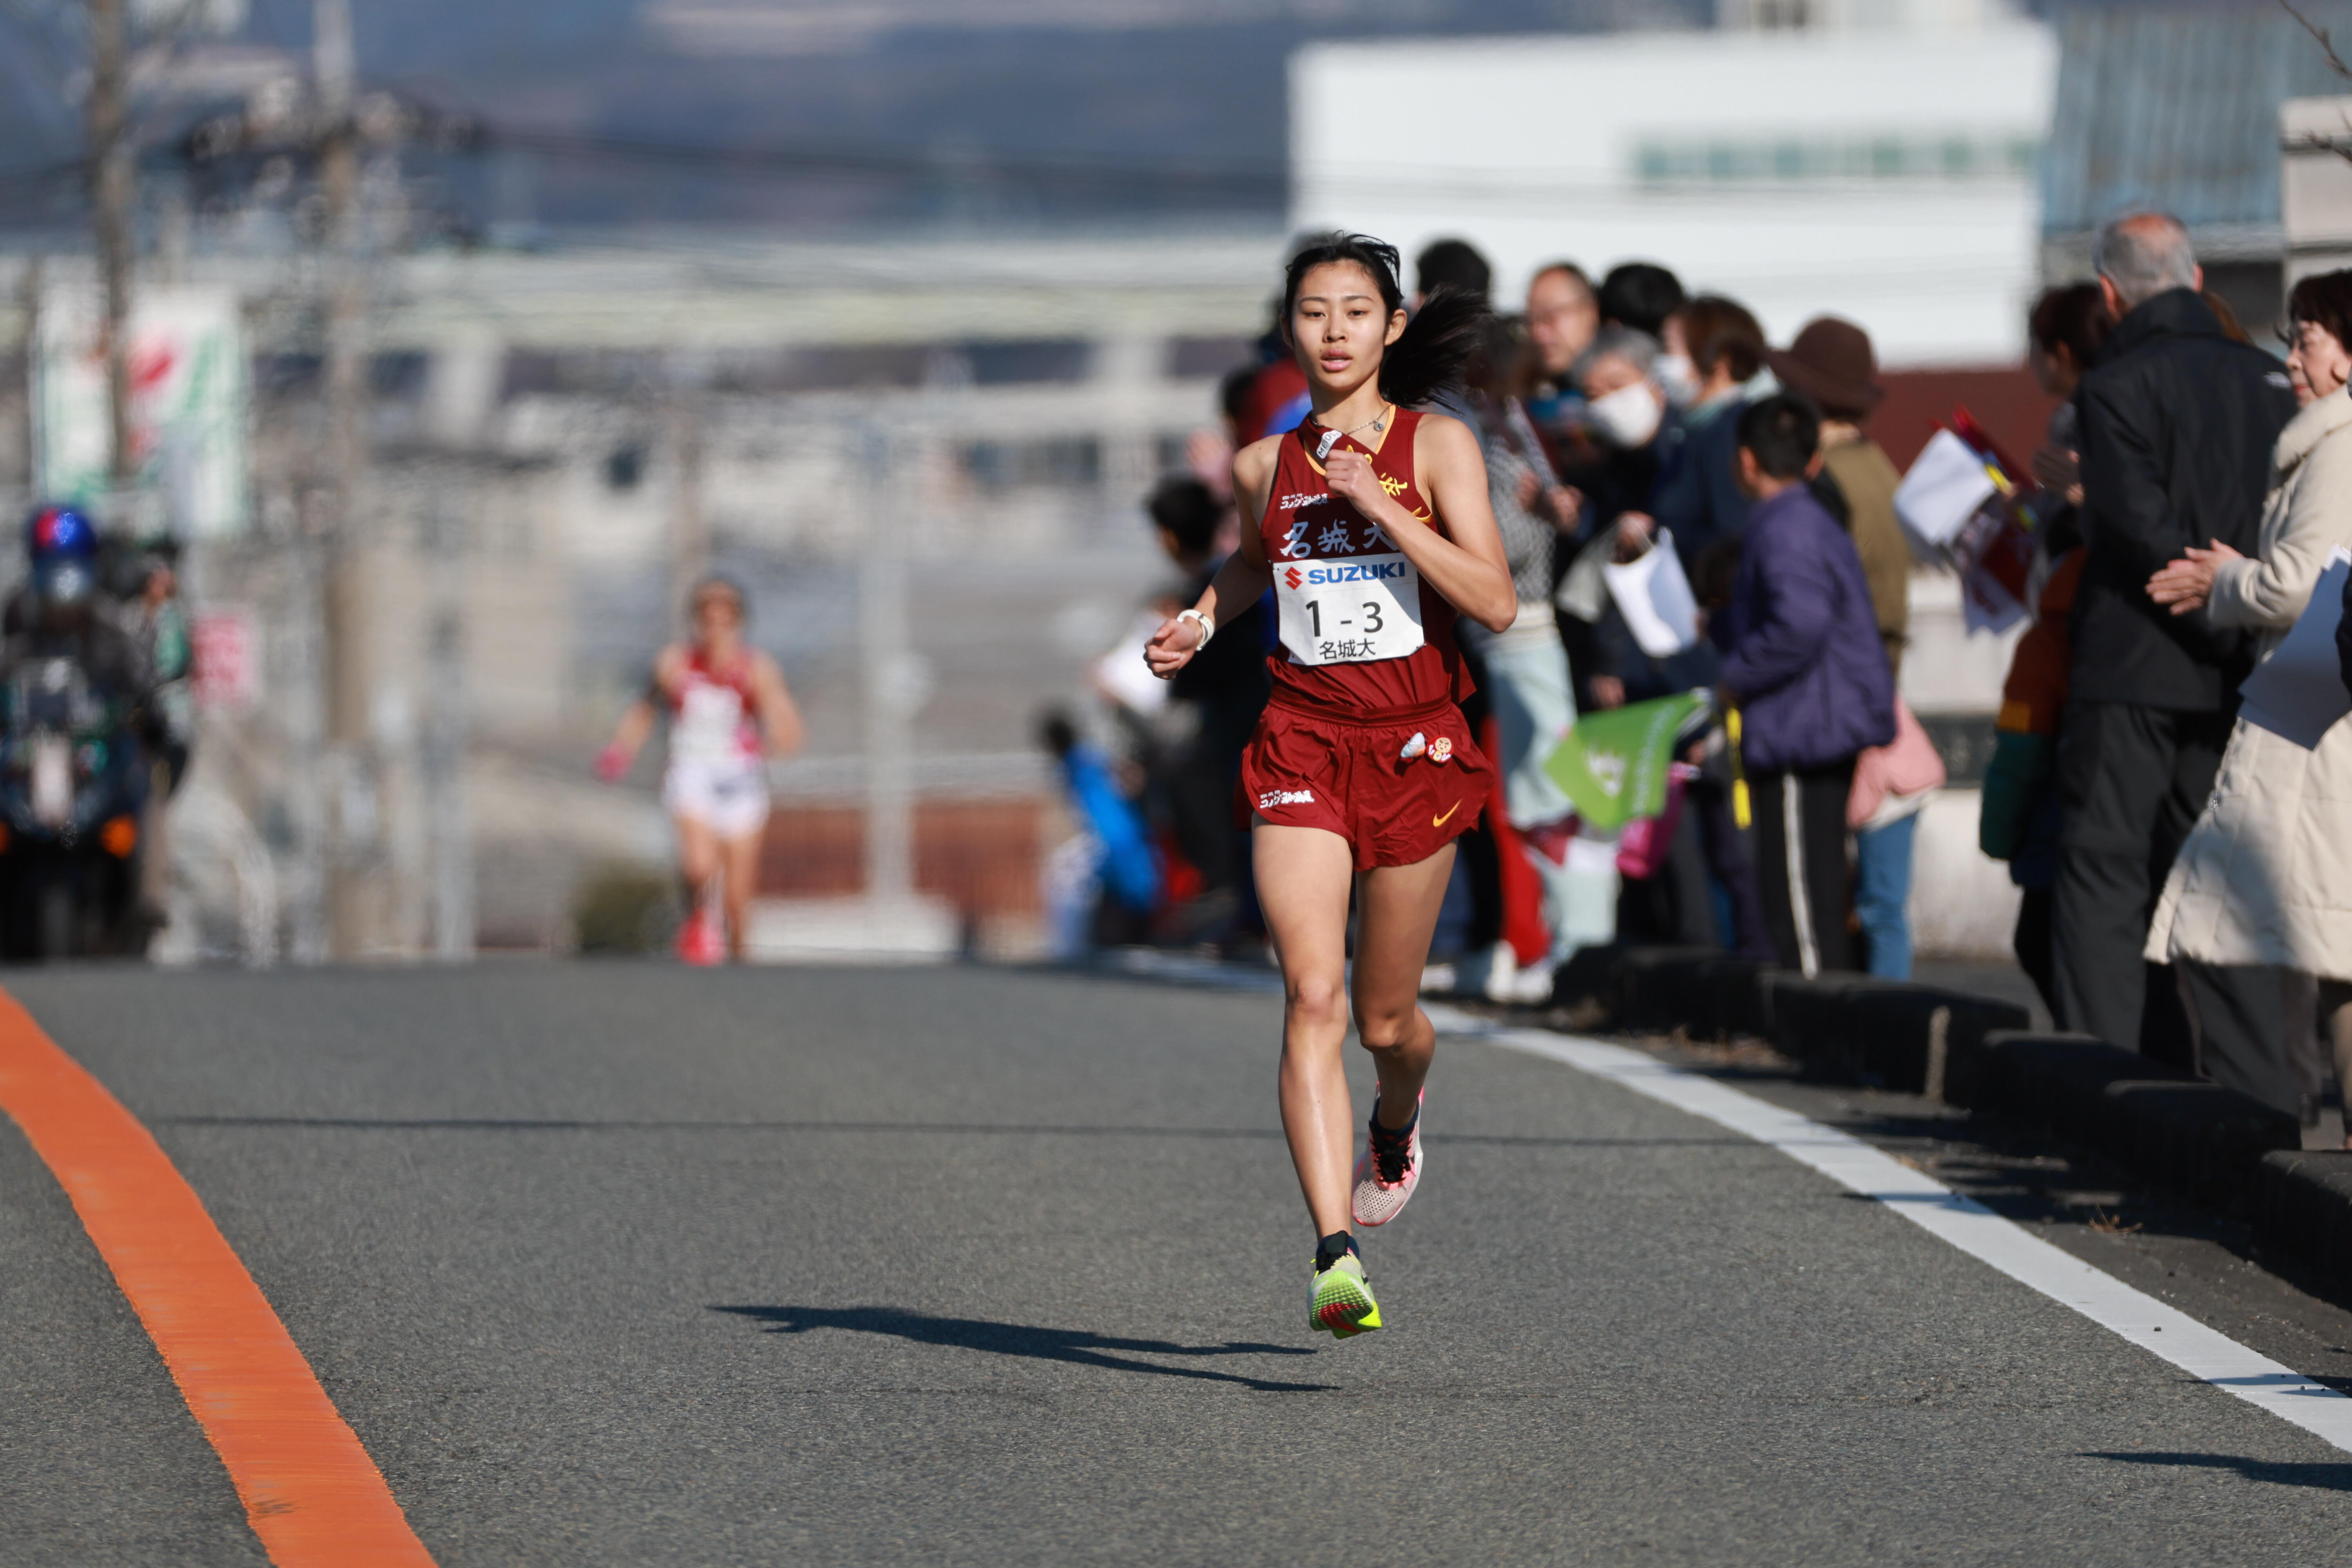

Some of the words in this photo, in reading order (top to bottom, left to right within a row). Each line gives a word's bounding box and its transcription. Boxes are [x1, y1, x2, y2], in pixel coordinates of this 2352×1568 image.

[1279, 519, 1399, 558] 名城大
[1308, 562, 1405, 585] SUZUKI
[1319, 638, 1376, 659] 名城大
